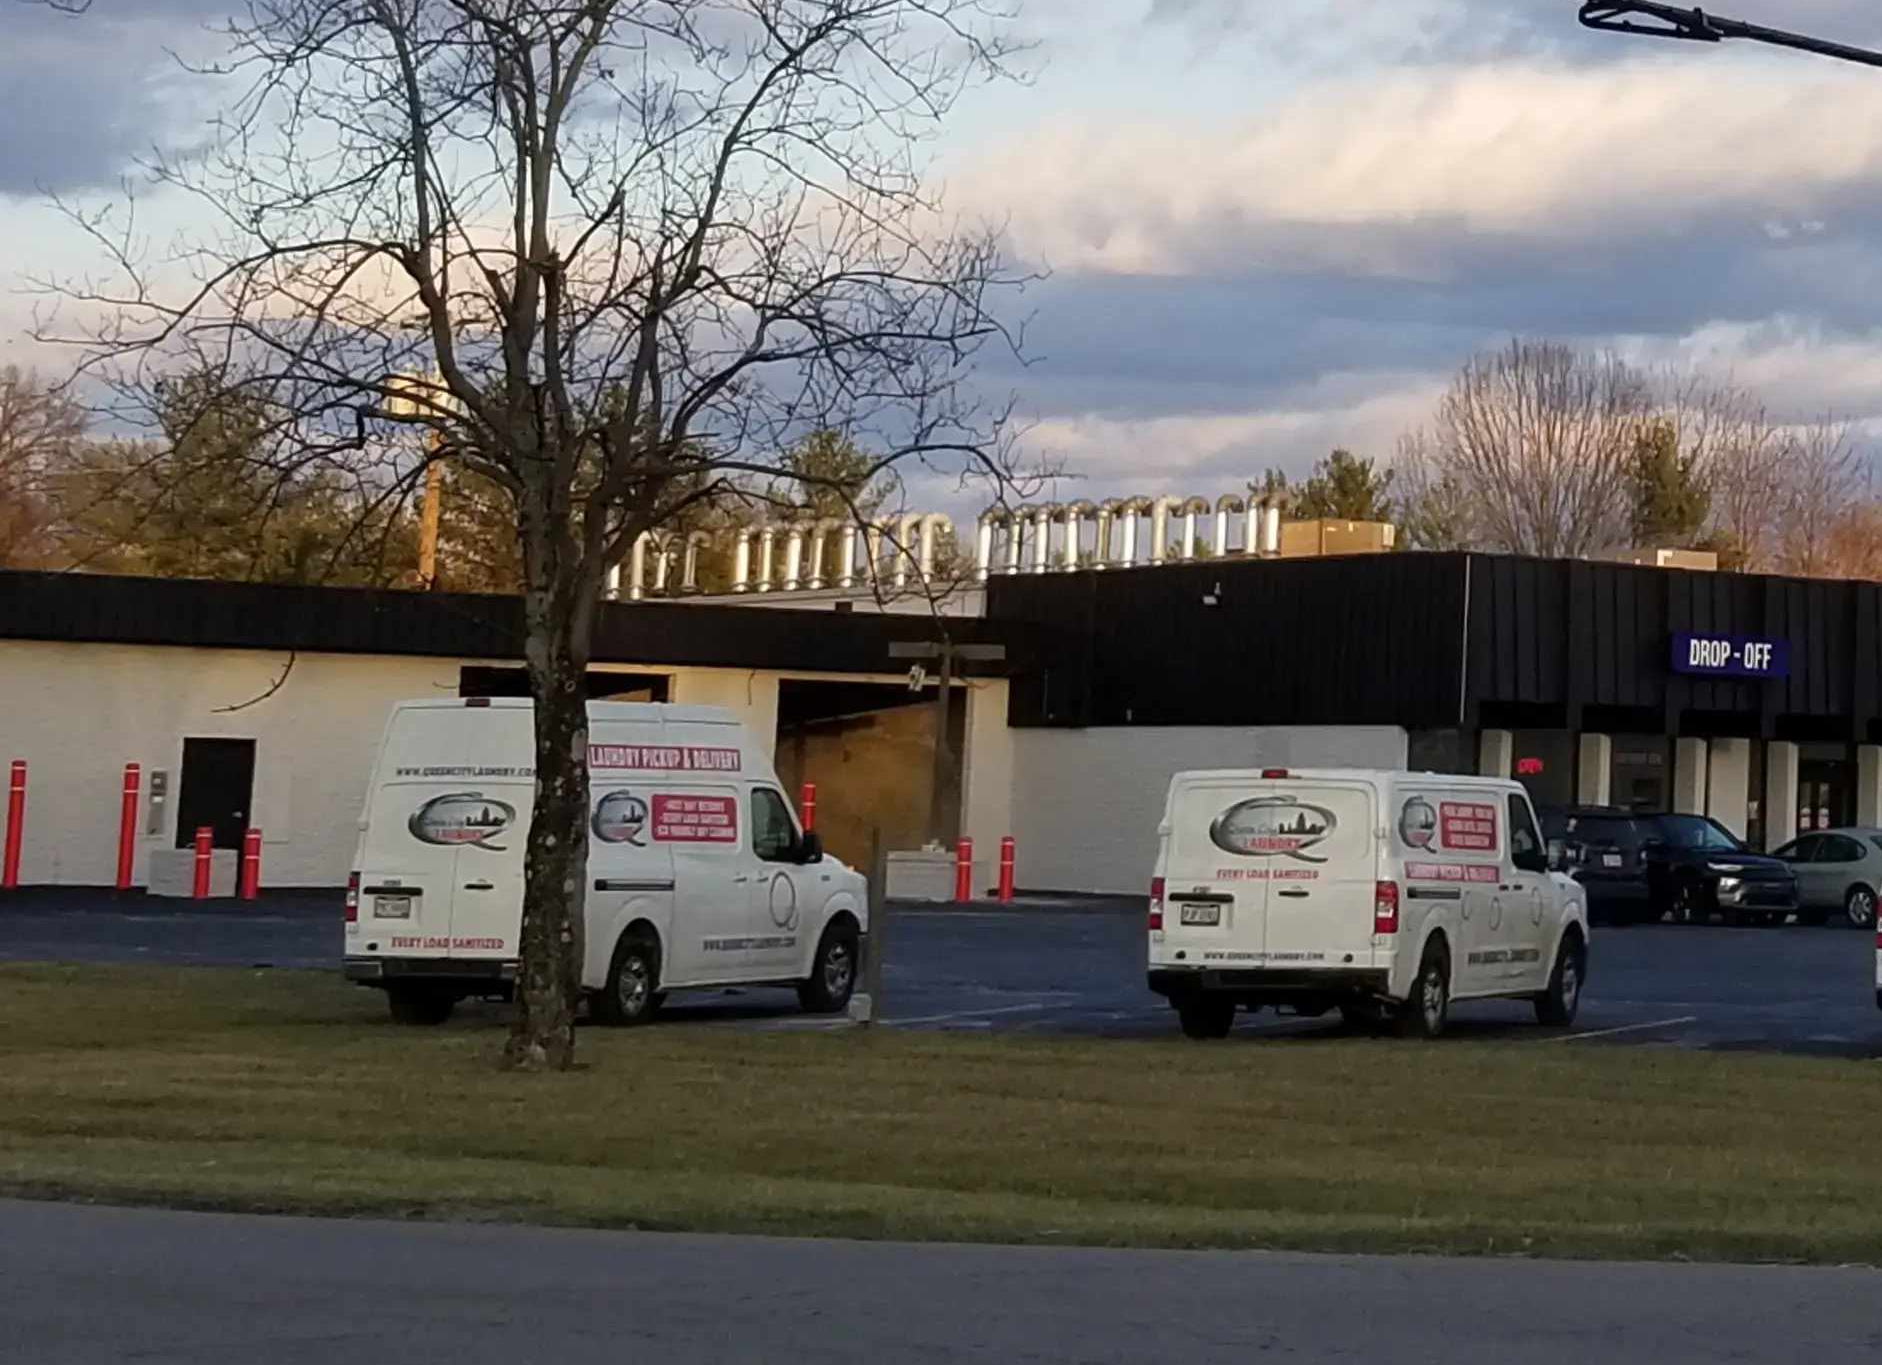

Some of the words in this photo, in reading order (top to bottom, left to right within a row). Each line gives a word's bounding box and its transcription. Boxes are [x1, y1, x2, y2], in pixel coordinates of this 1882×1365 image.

[1689, 639, 1731, 667] DROP
[590, 746, 640, 767] LAUNDRY
[641, 748, 681, 769] PICKUP
[692, 750, 739, 770] DELIVERY
[423, 937, 449, 949] LOAD
